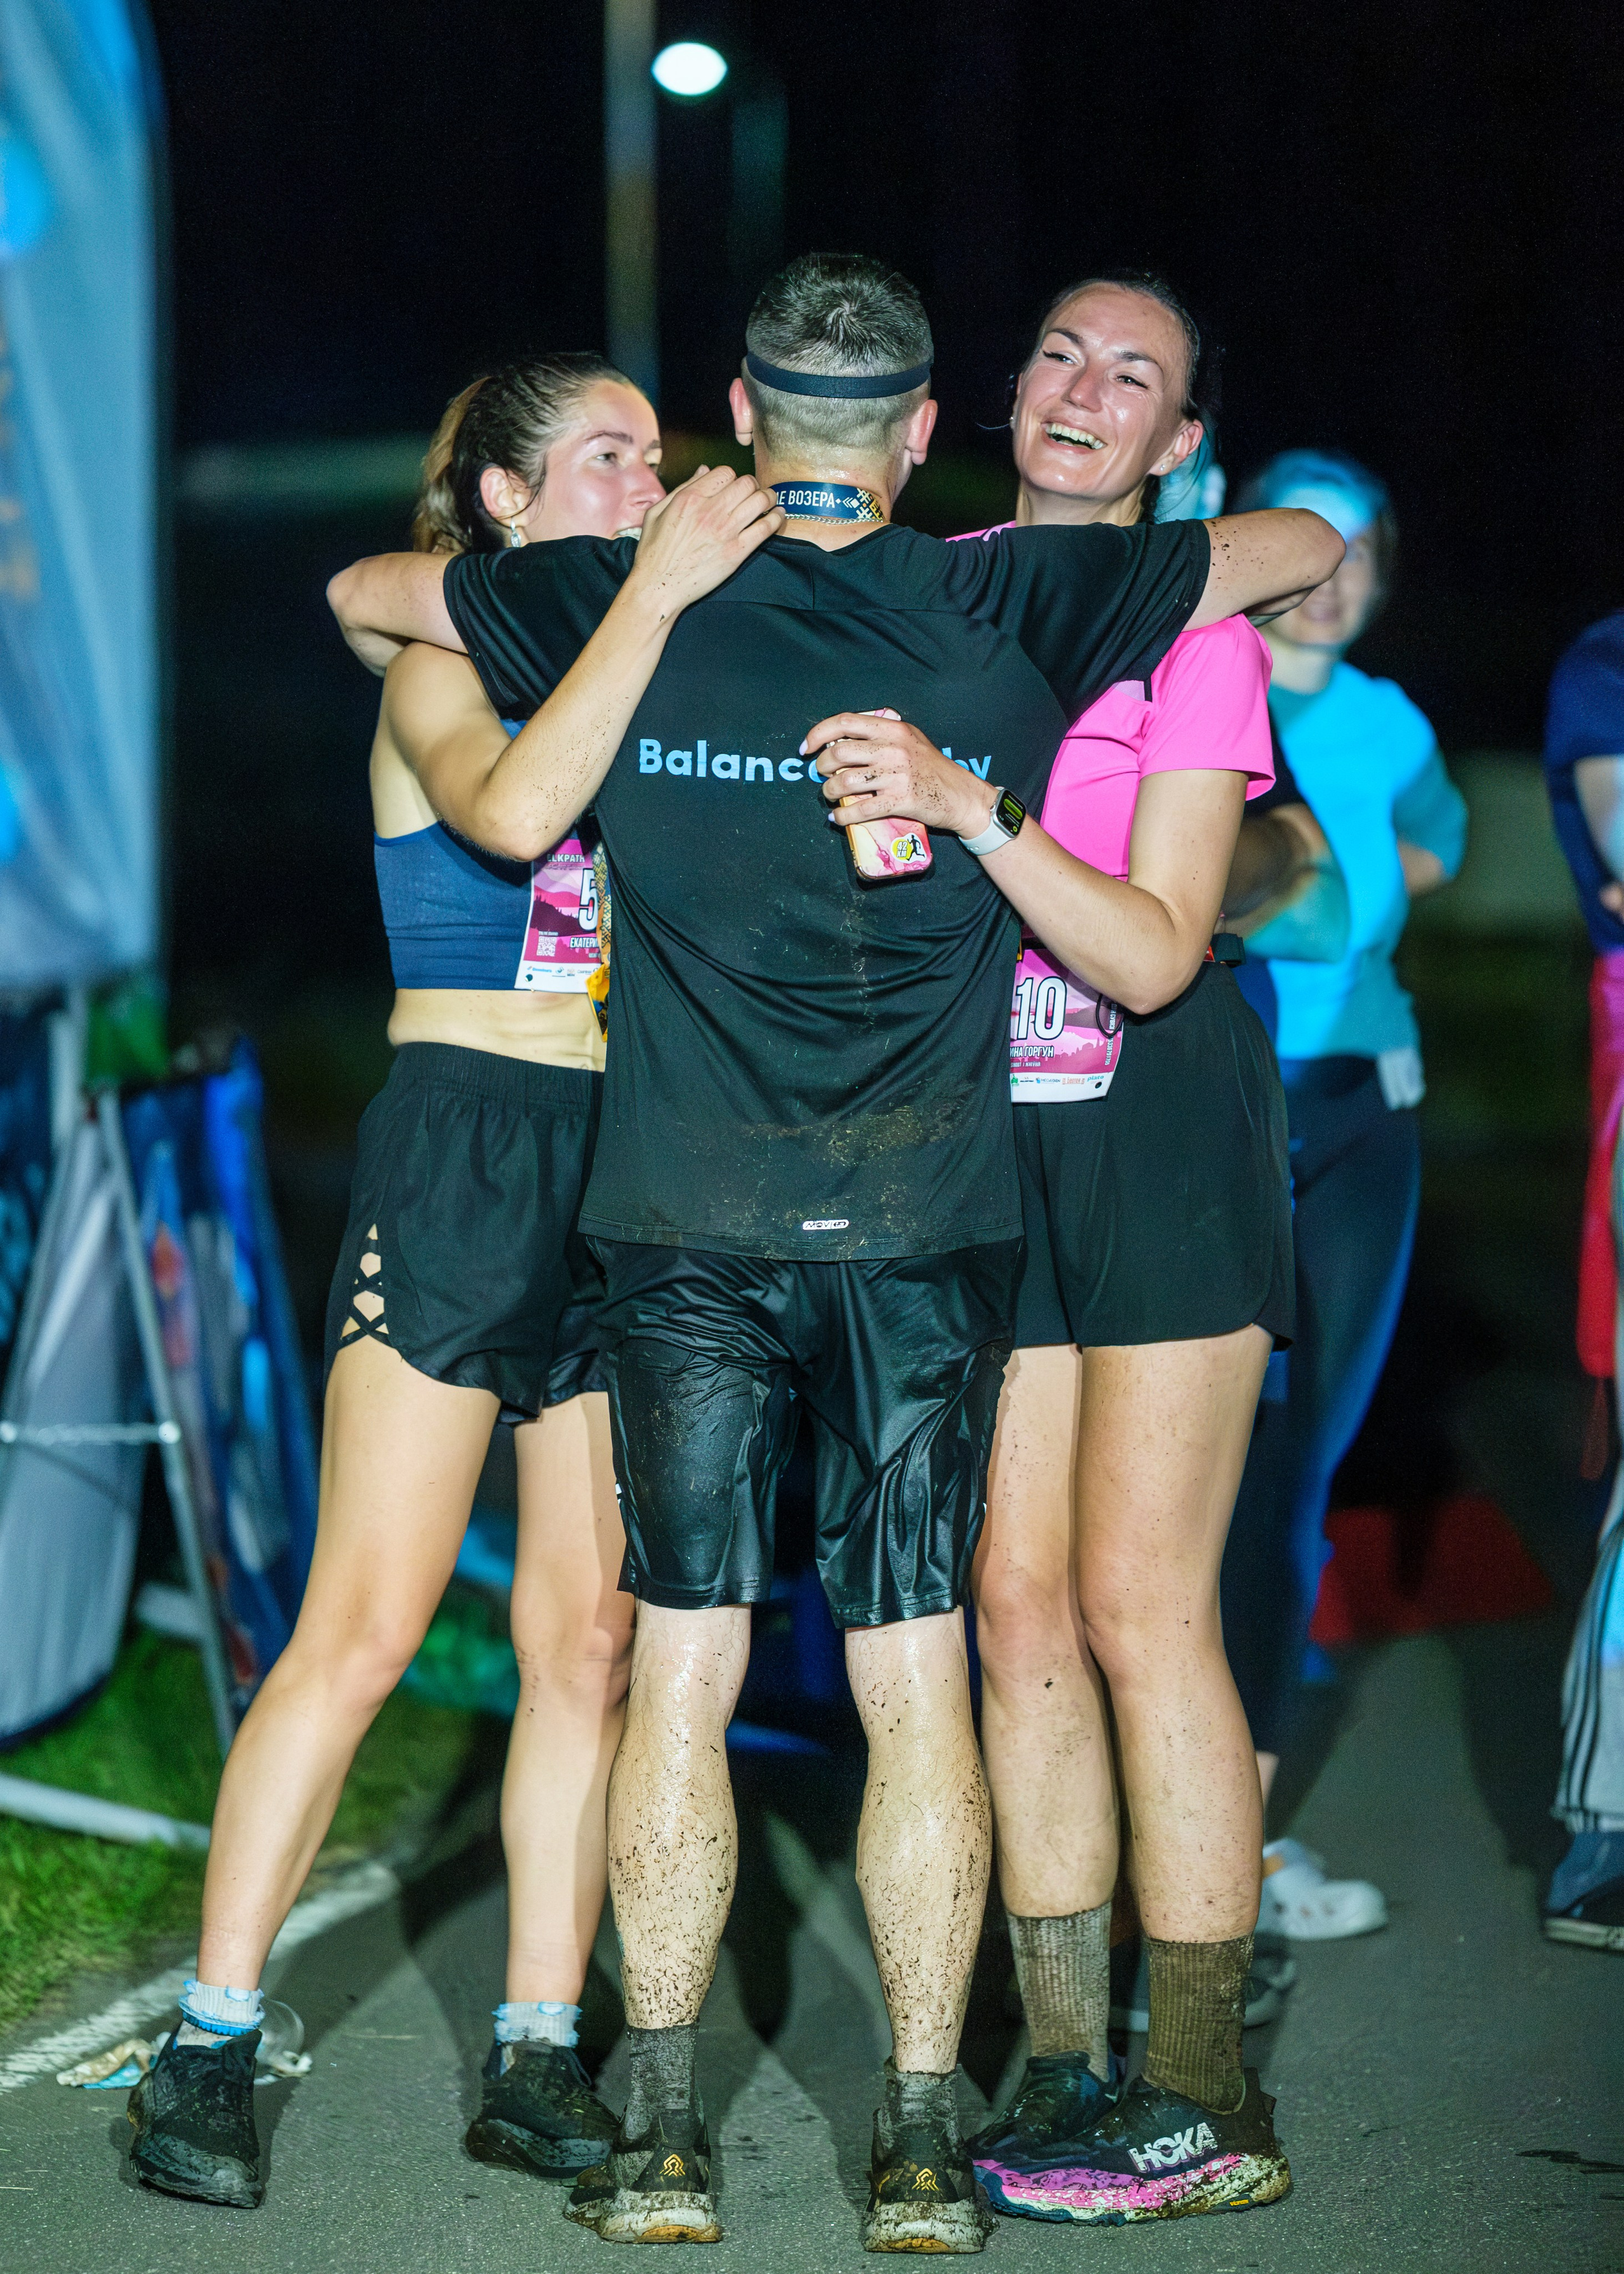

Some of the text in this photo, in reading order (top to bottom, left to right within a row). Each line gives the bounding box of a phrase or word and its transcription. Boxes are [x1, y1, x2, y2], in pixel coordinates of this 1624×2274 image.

[788, 490, 835, 508] ВОЗЕРА
[896, 841, 908, 850] 42
[570, 937, 599, 948] ЕКАТЕРИ
[1024, 1046, 1054, 1058] ГОРГУН
[1127, 2122, 1218, 2172] HOKA
